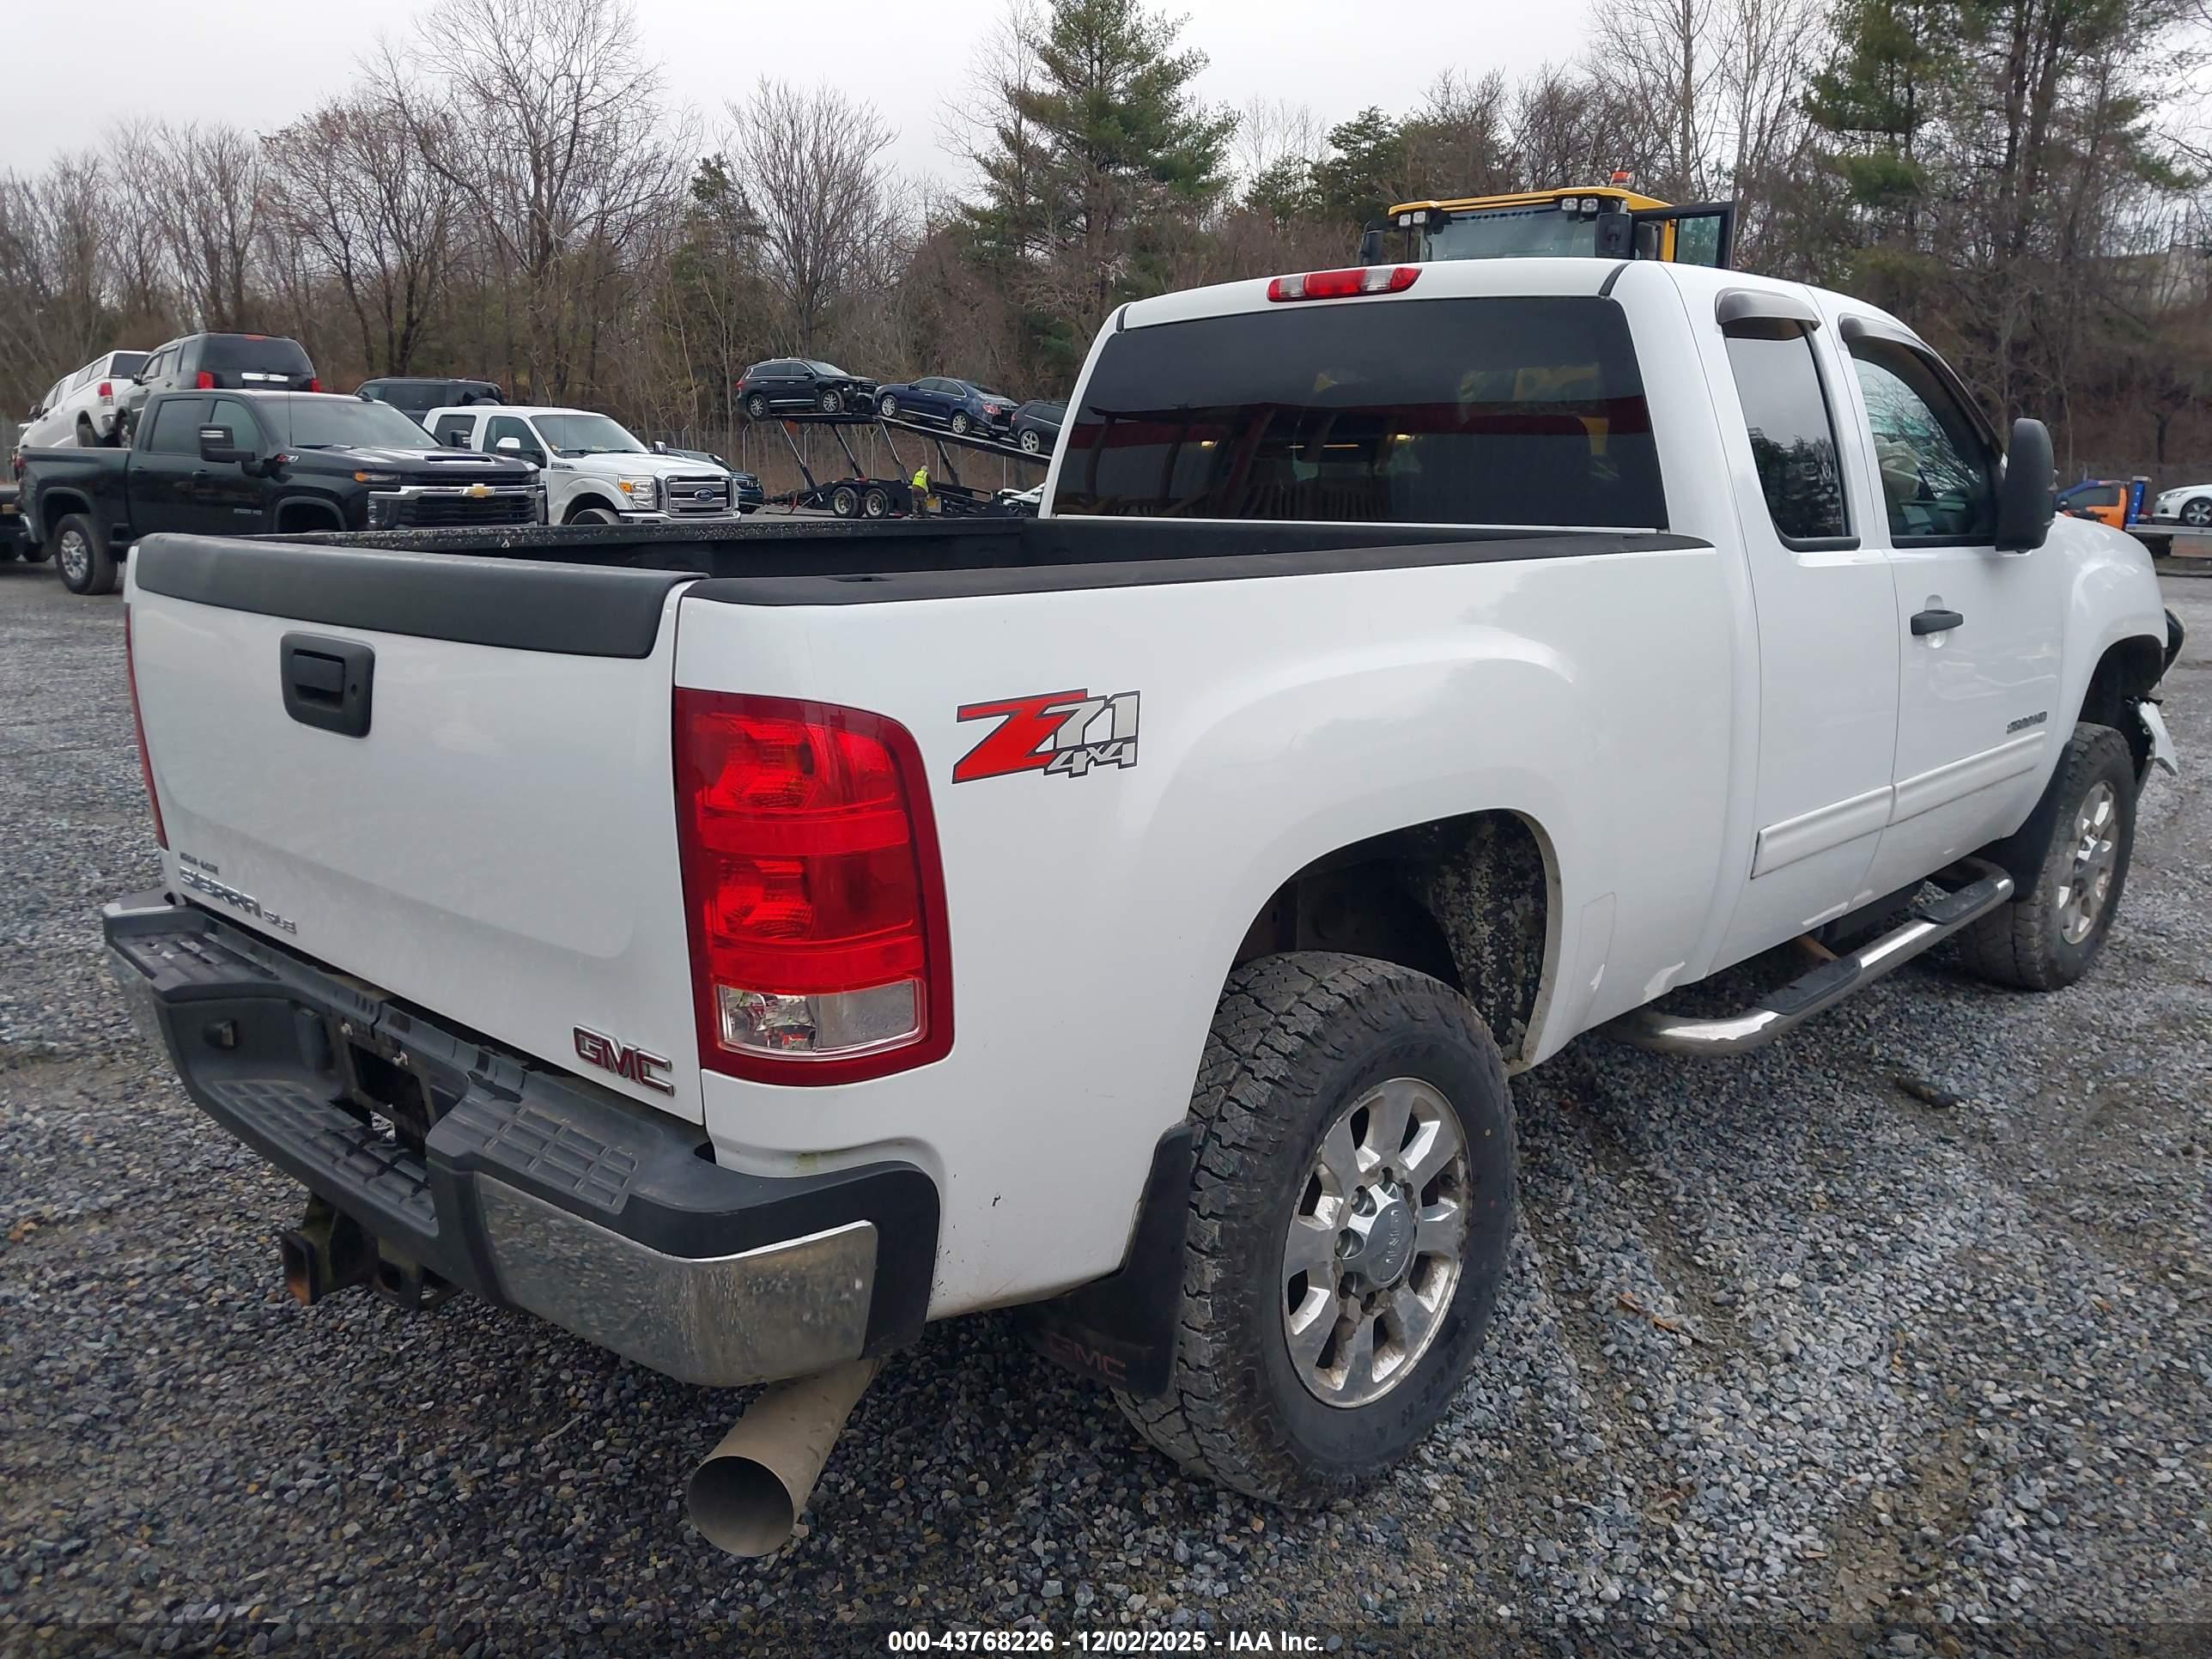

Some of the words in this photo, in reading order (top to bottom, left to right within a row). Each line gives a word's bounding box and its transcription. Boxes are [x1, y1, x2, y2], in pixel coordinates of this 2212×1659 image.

[951, 688, 1140, 784] Z71
[179, 866, 262, 918] SIERRA
[264, 908, 297, 934] SLE
[573, 1024, 675, 1097] GMC
[1042, 1332, 1127, 1382] GMC
